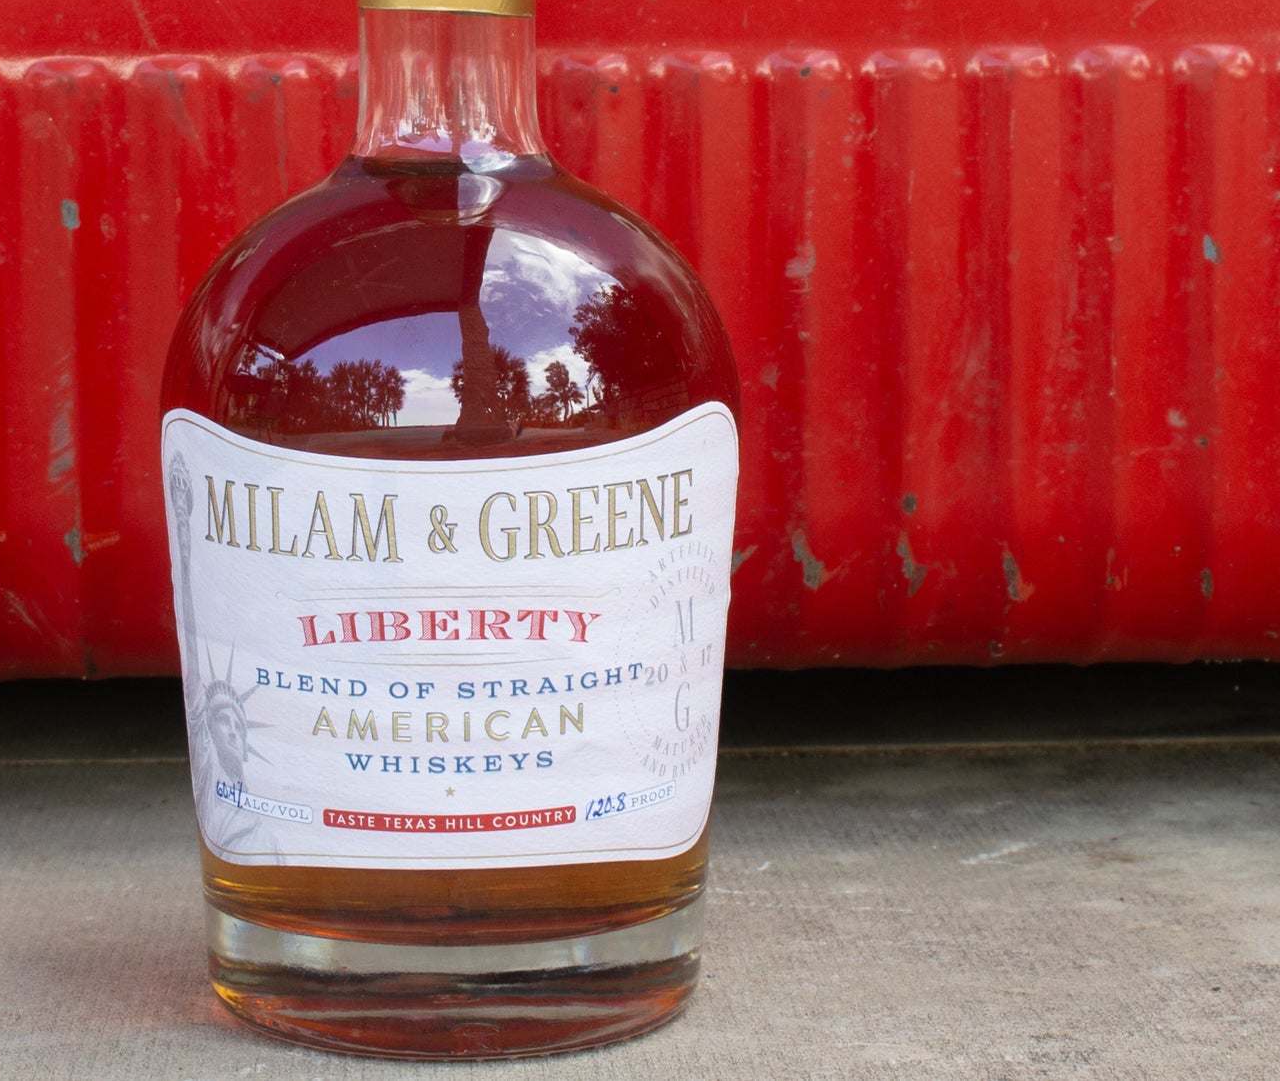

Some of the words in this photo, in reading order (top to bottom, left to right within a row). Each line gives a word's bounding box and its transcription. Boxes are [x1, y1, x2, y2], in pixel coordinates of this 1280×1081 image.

[204, 474, 405, 563] MILAM
[427, 504, 459, 554] &
[478, 468, 694, 563] GREENE
[296, 608, 604, 648] LIBERTY
[255, 667, 368, 698] BLEND
[388, 680, 436, 700] OF
[457, 661, 644, 700] STRAIGHT
[644, 662, 669, 687] 20
[674, 680, 691, 733] G
[311, 702, 584, 743] AMERICAN
[344, 750, 554, 774] WHISKEYS
[243, 796, 309, 820] ALC/VOL
[585, 791, 627, 821] 120.8
[631, 785, 674, 808] PROOF
[328, 811, 376, 828] TASTE
[383, 816, 437, 830] TEXAS
[445, 817, 485, 830] HILL
[492, 809, 574, 828] COUNTRY
